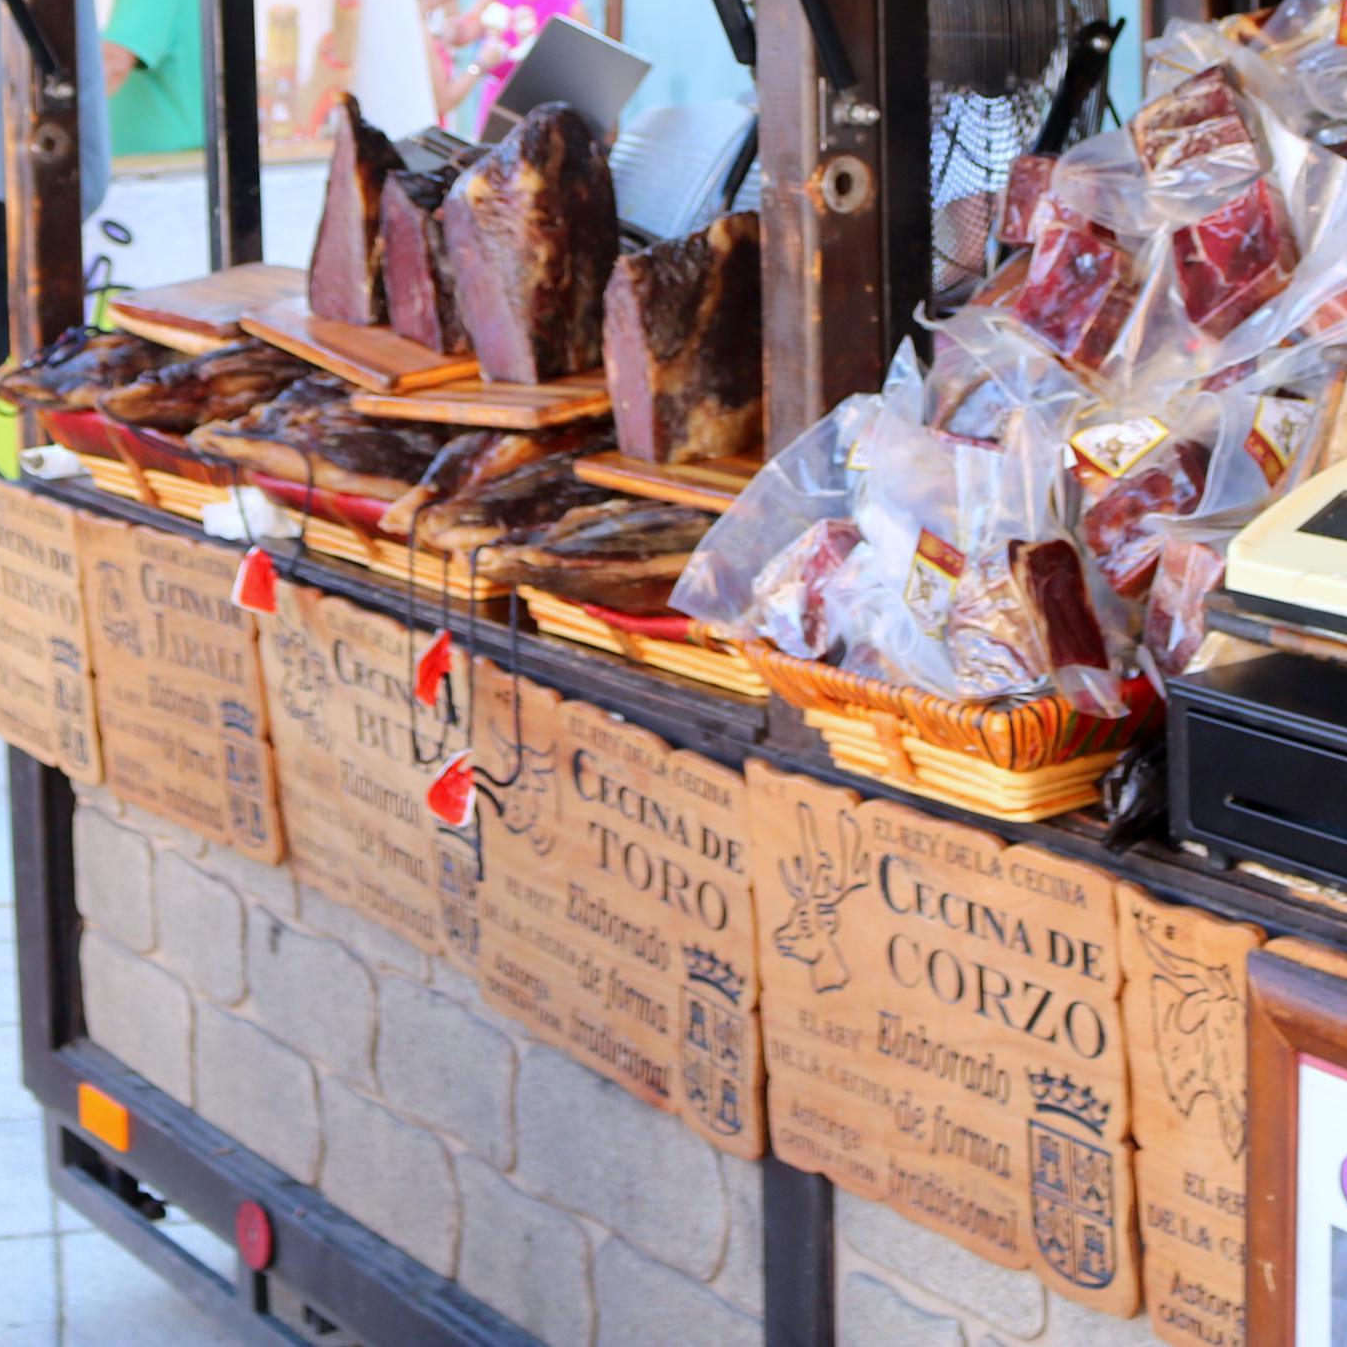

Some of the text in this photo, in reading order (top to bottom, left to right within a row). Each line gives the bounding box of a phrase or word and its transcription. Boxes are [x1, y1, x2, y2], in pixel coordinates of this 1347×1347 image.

[50, 548, 73, 578] DE
[333, 638, 433, 714] CECIN
[571, 748, 745, 875] CECINA DE
[587, 820, 728, 932] TORO
[872, 816, 898, 845] EL
[944, 839, 973, 870] DE
[974, 852, 1004, 881] LA
[1009, 861, 1089, 910] CECINA
[877, 852, 1106, 982] CECINA DE
[887, 932, 1107, 1060] CORZO
[876, 1009, 1012, 1104] Elaborado
[894, 1088, 1012, 1180] de forma
[1147, 1203, 1176, 1236] DE
[1179, 1216, 1213, 1253] LA
[1183, 1172, 1247, 1218] EL RE
[1169, 1269, 1247, 1326] Astorg
